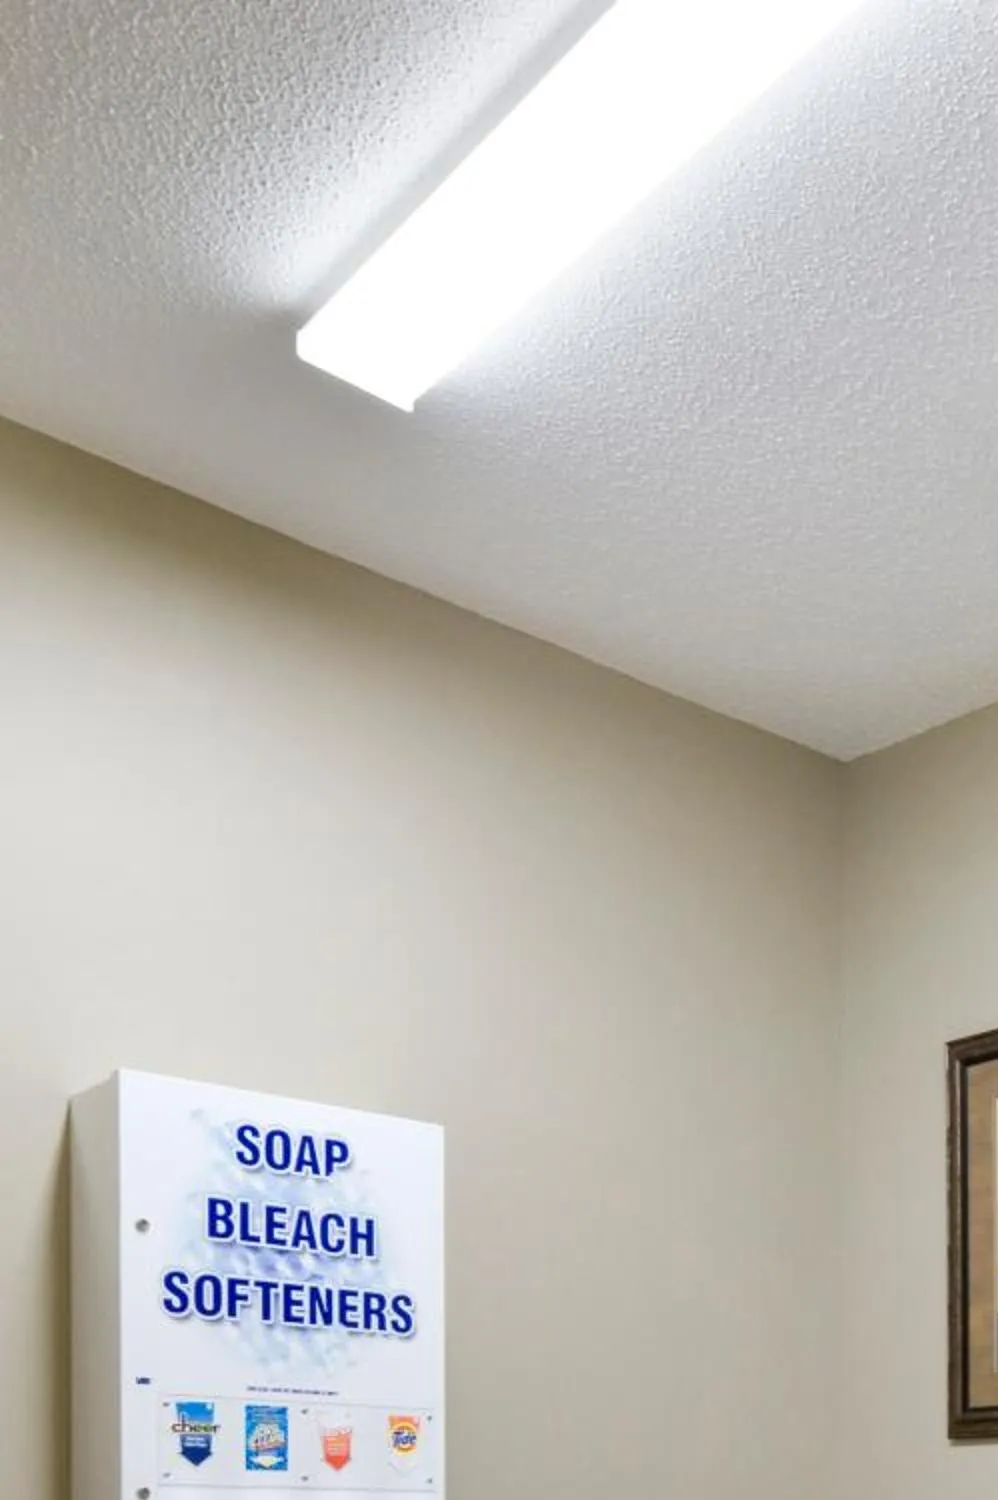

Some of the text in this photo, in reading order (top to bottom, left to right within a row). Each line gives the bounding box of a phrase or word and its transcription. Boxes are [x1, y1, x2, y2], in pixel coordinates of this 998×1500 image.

[235, 1124, 350, 1177] SOAP
[207, 1197, 376, 1257] BLEACH
[162, 1270, 414, 1334] SOFTENERS
[171, 1412, 221, 1434] cheer
